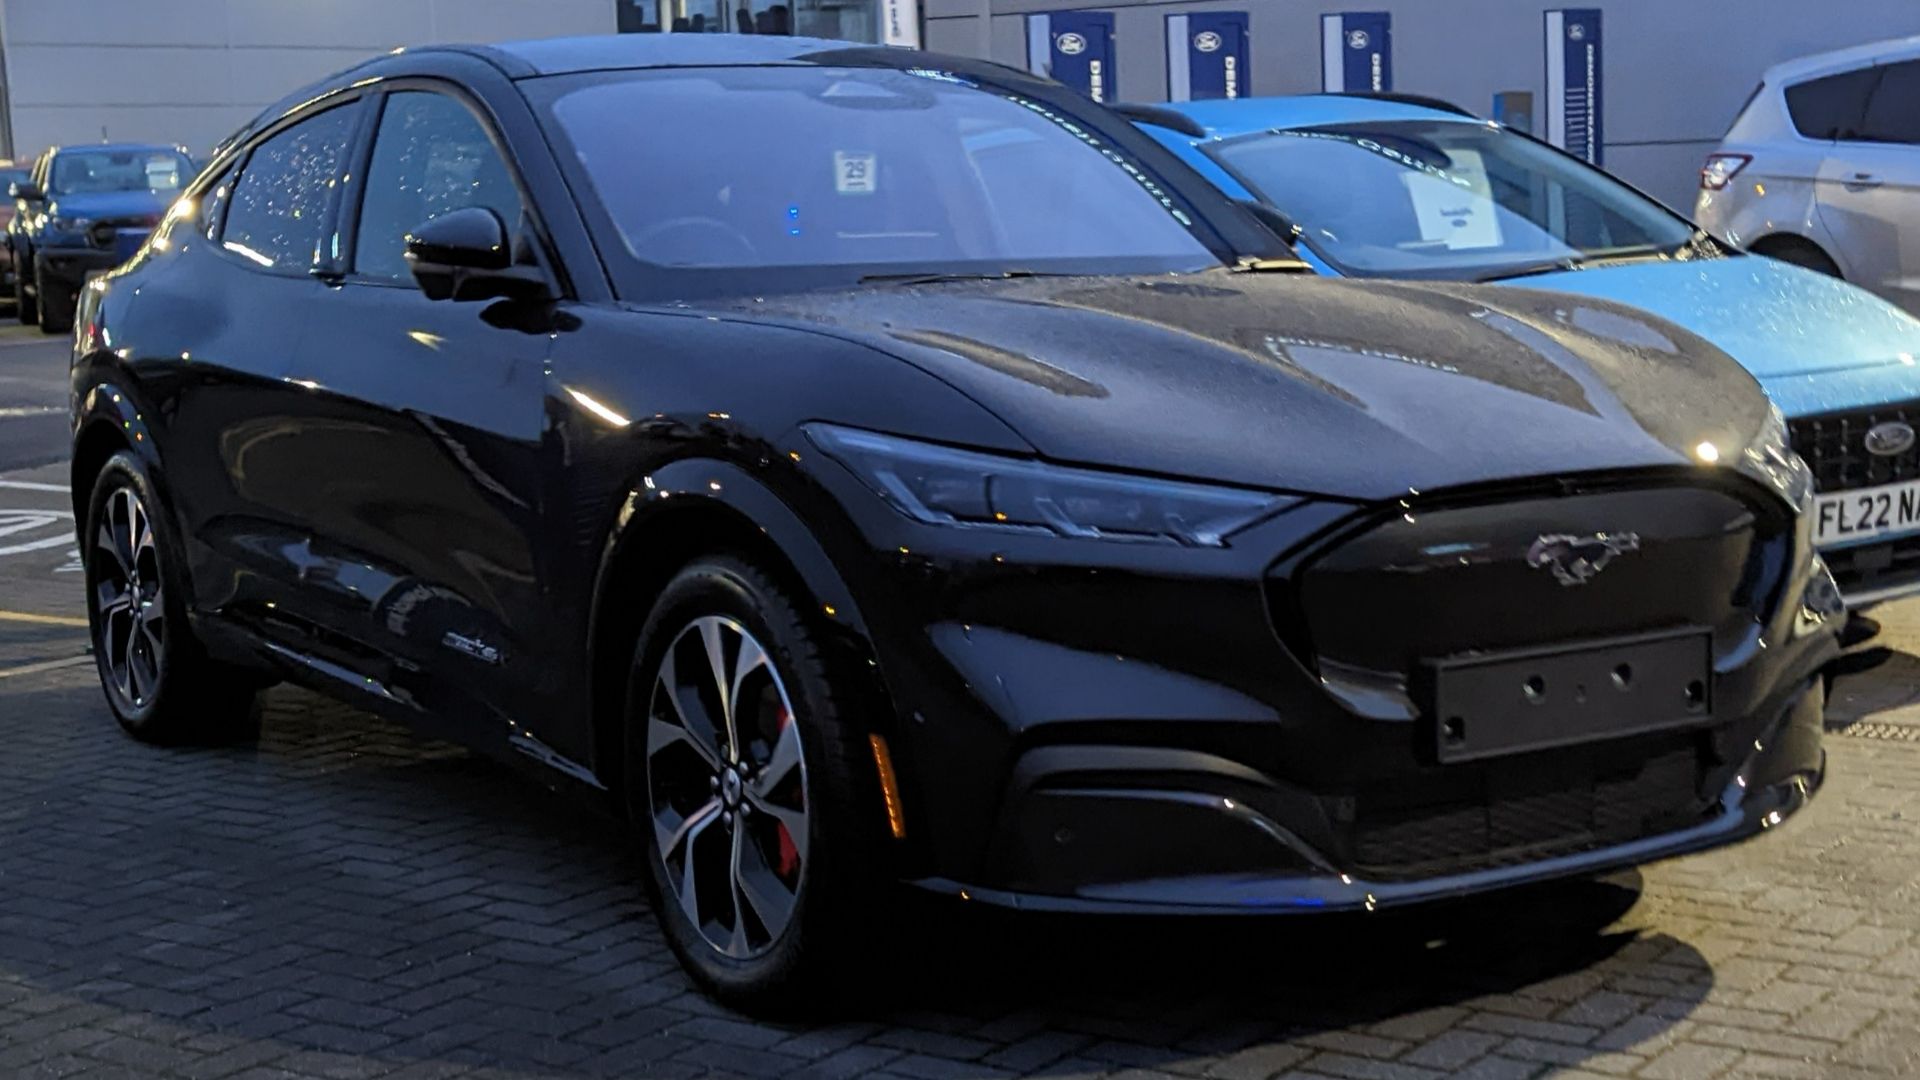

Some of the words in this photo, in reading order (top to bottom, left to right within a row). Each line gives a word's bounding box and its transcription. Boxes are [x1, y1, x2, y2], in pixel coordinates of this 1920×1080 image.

[1225, 56, 1236, 99] DEM
[1818, 493, 1891, 537] FL22
[1898, 488, 1920, 524] N
